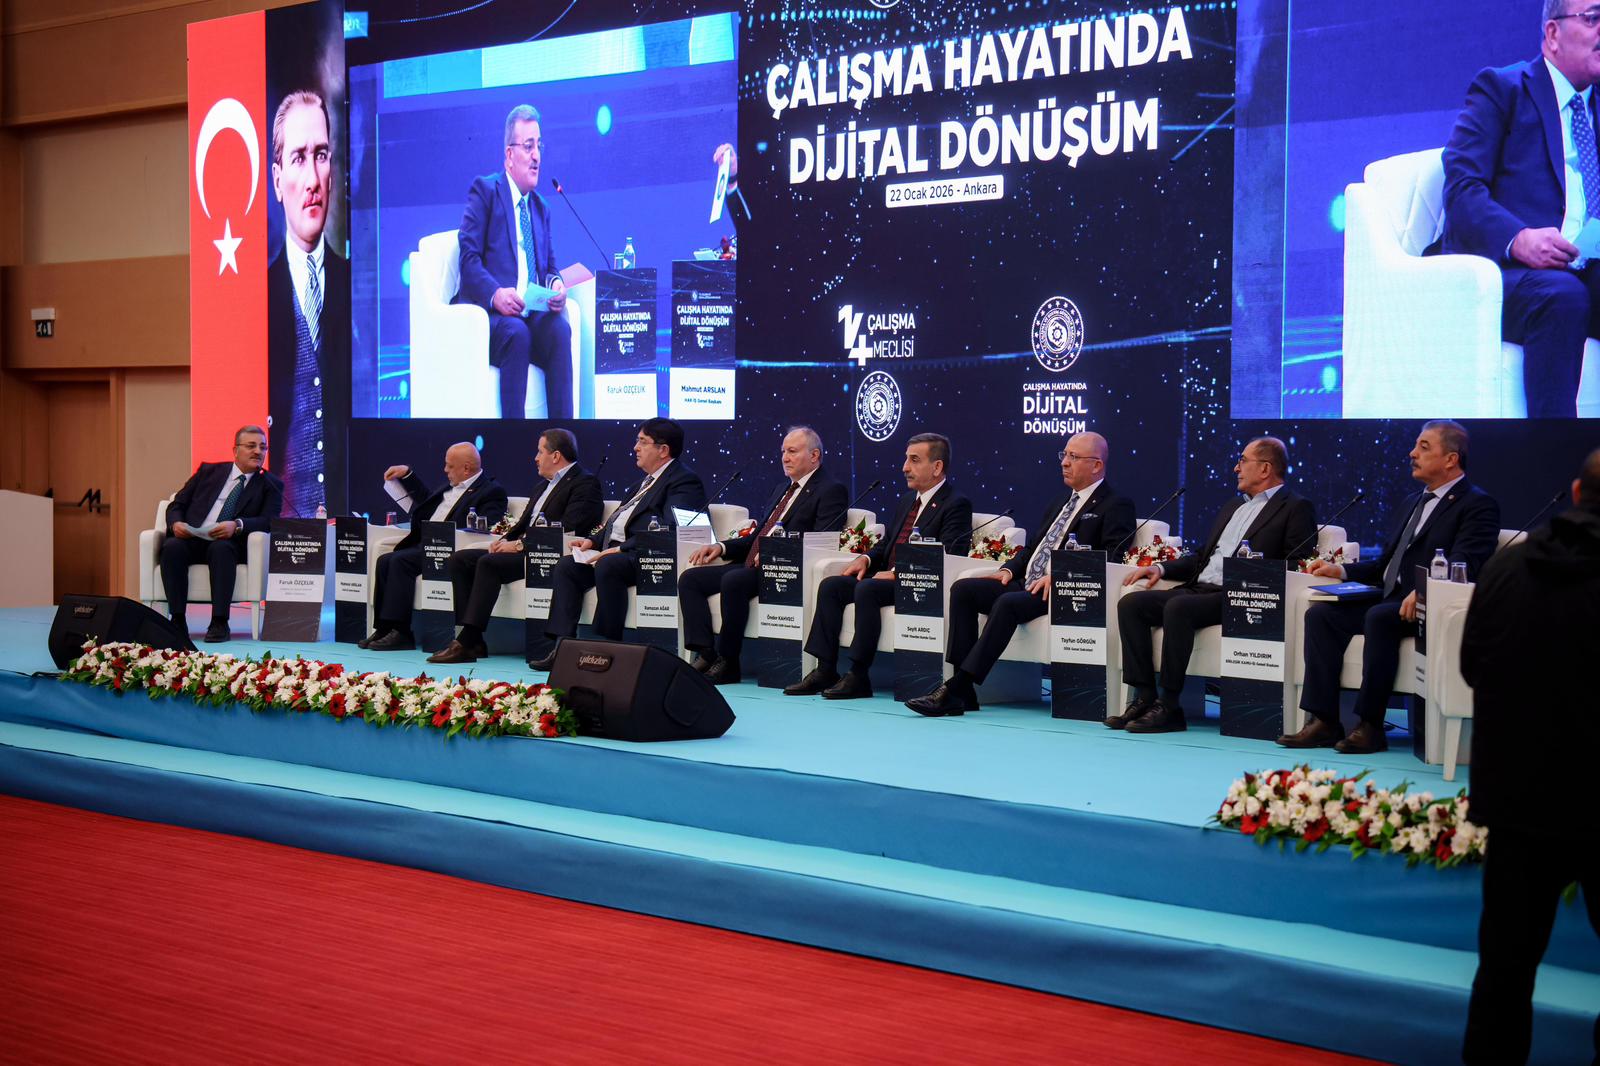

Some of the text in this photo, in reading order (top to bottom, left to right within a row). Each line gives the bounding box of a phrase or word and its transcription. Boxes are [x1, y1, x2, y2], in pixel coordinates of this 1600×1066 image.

[766, 7, 1193, 120] ÇALIŞMA HAYATINDA
[789, 90, 1159, 184] DİJİTAL DÖNÜŞÜM
[890, 189, 902, 202] 22
[904, 185, 927, 200] Ocak
[929, 185, 954, 199] 2026
[964, 181, 998, 196] Ankara
[677, 305, 733, 316] ÇALIŞMA HAYATINDA
[600, 312, 651, 324] ÇALIŞMA HAYATINDA
[680, 316, 730, 328] DİJİTAL DÖNÜŞÜM
[622, 322, 648, 333] DÖNÜŞÜM
[867, 313, 916, 336] ÇALIŞMA
[873, 336, 914, 358] MECLİSİ
[608, 386, 623, 394] Faruk
[681, 386, 726, 394] Mahmut ARSLAN
[1022, 382, 1088, 392] ÇALIŞMA HAYATINDA
[1023, 392, 1088, 414] DİJİTAL
[1024, 418, 1086, 436] DÖNÜŞÜM
[1250, 592, 1280, 600] HAYATINDA
[1250, 600, 1277, 609] DÖNÜŞÜM
